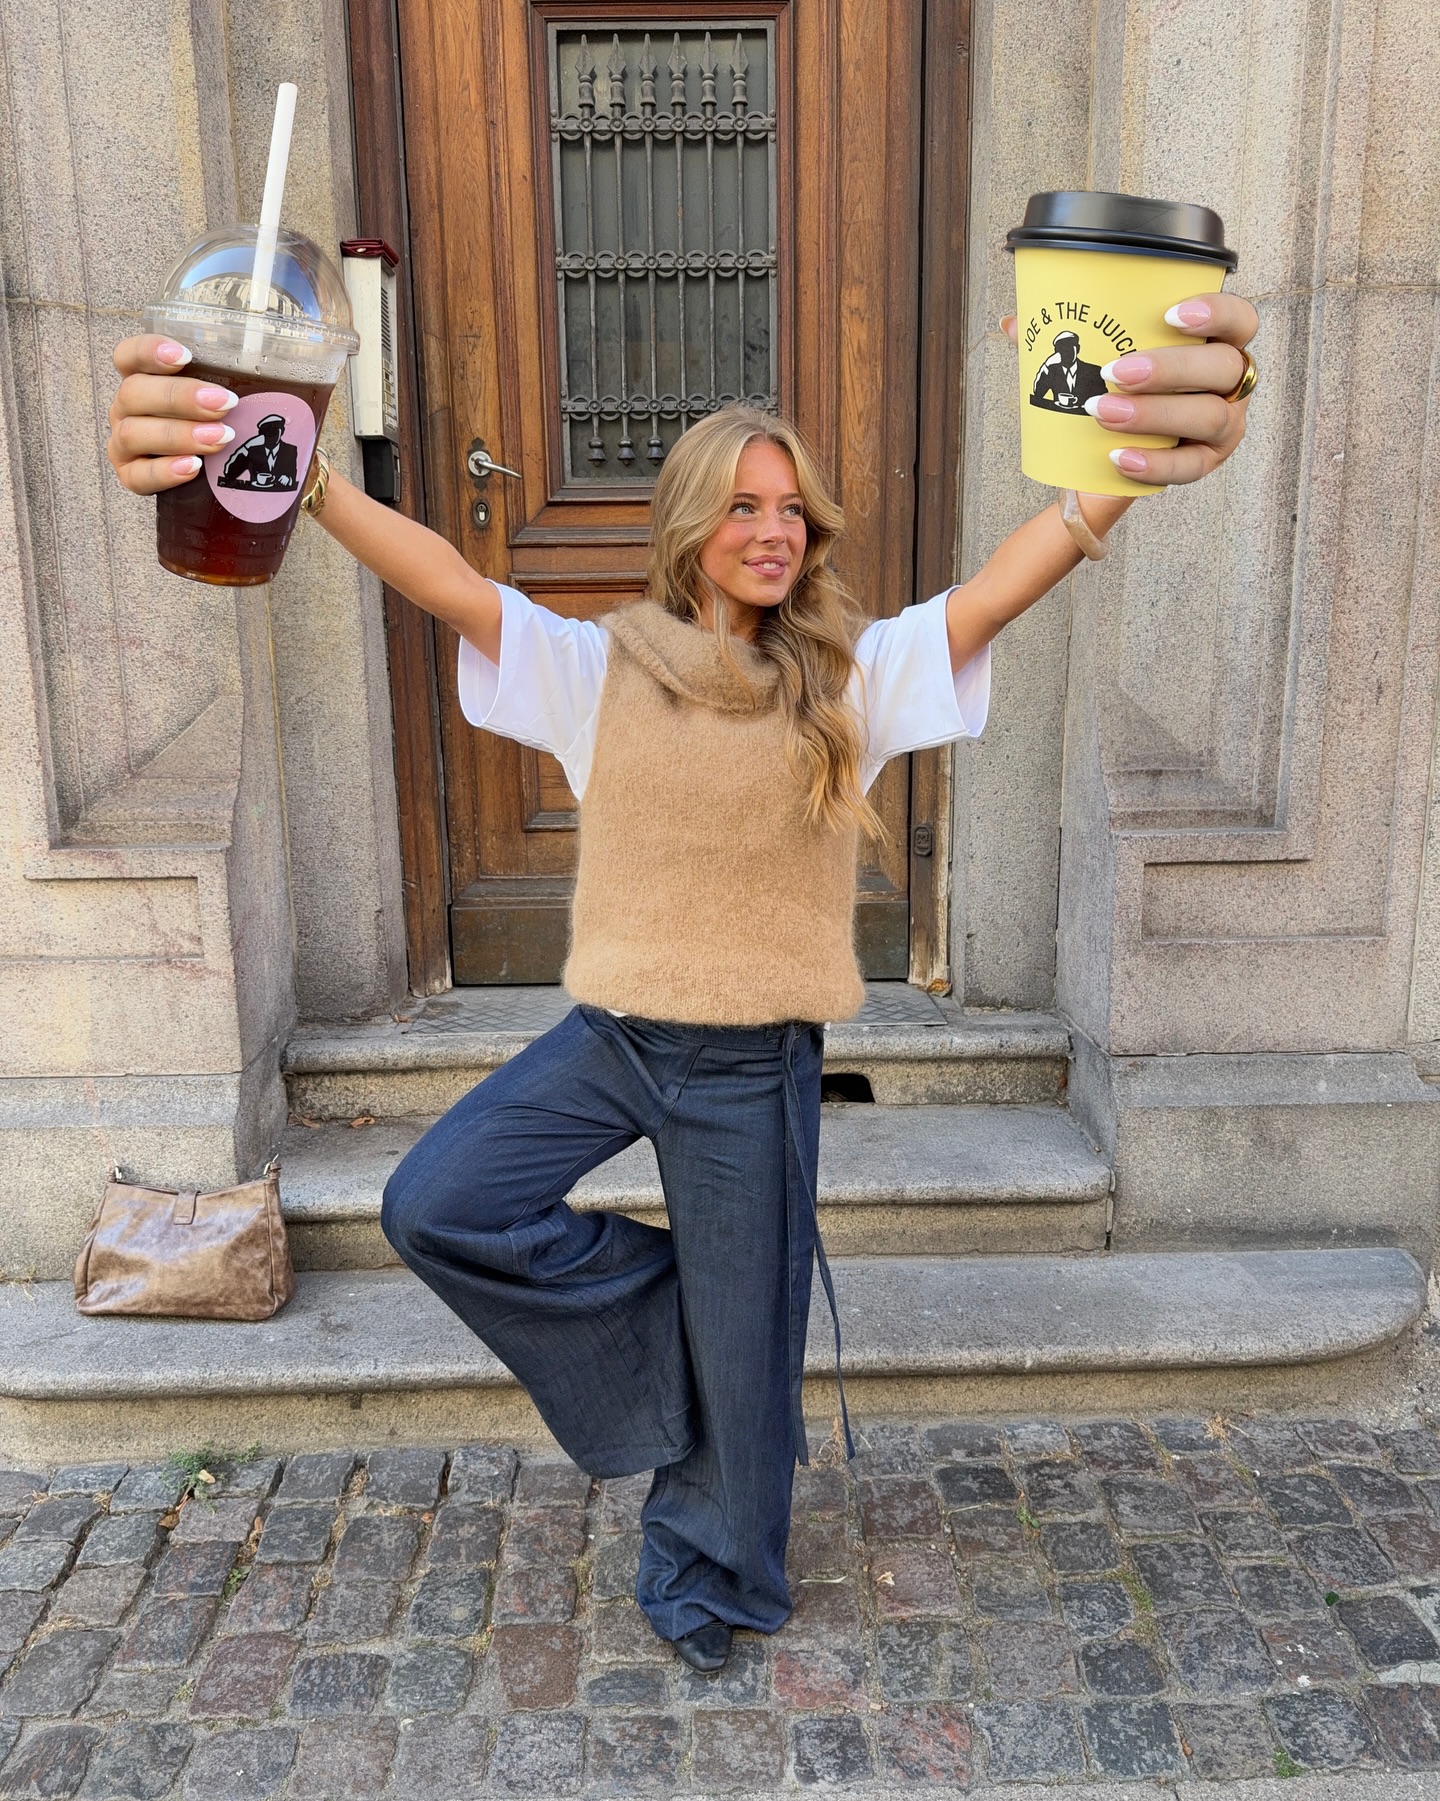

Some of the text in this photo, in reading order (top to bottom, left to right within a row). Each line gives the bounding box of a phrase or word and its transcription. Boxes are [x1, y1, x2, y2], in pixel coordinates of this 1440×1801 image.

[1024, 318, 1041, 351] JOE
[1041, 308, 1052, 325] &
[1055, 302, 1090, 323] THE
